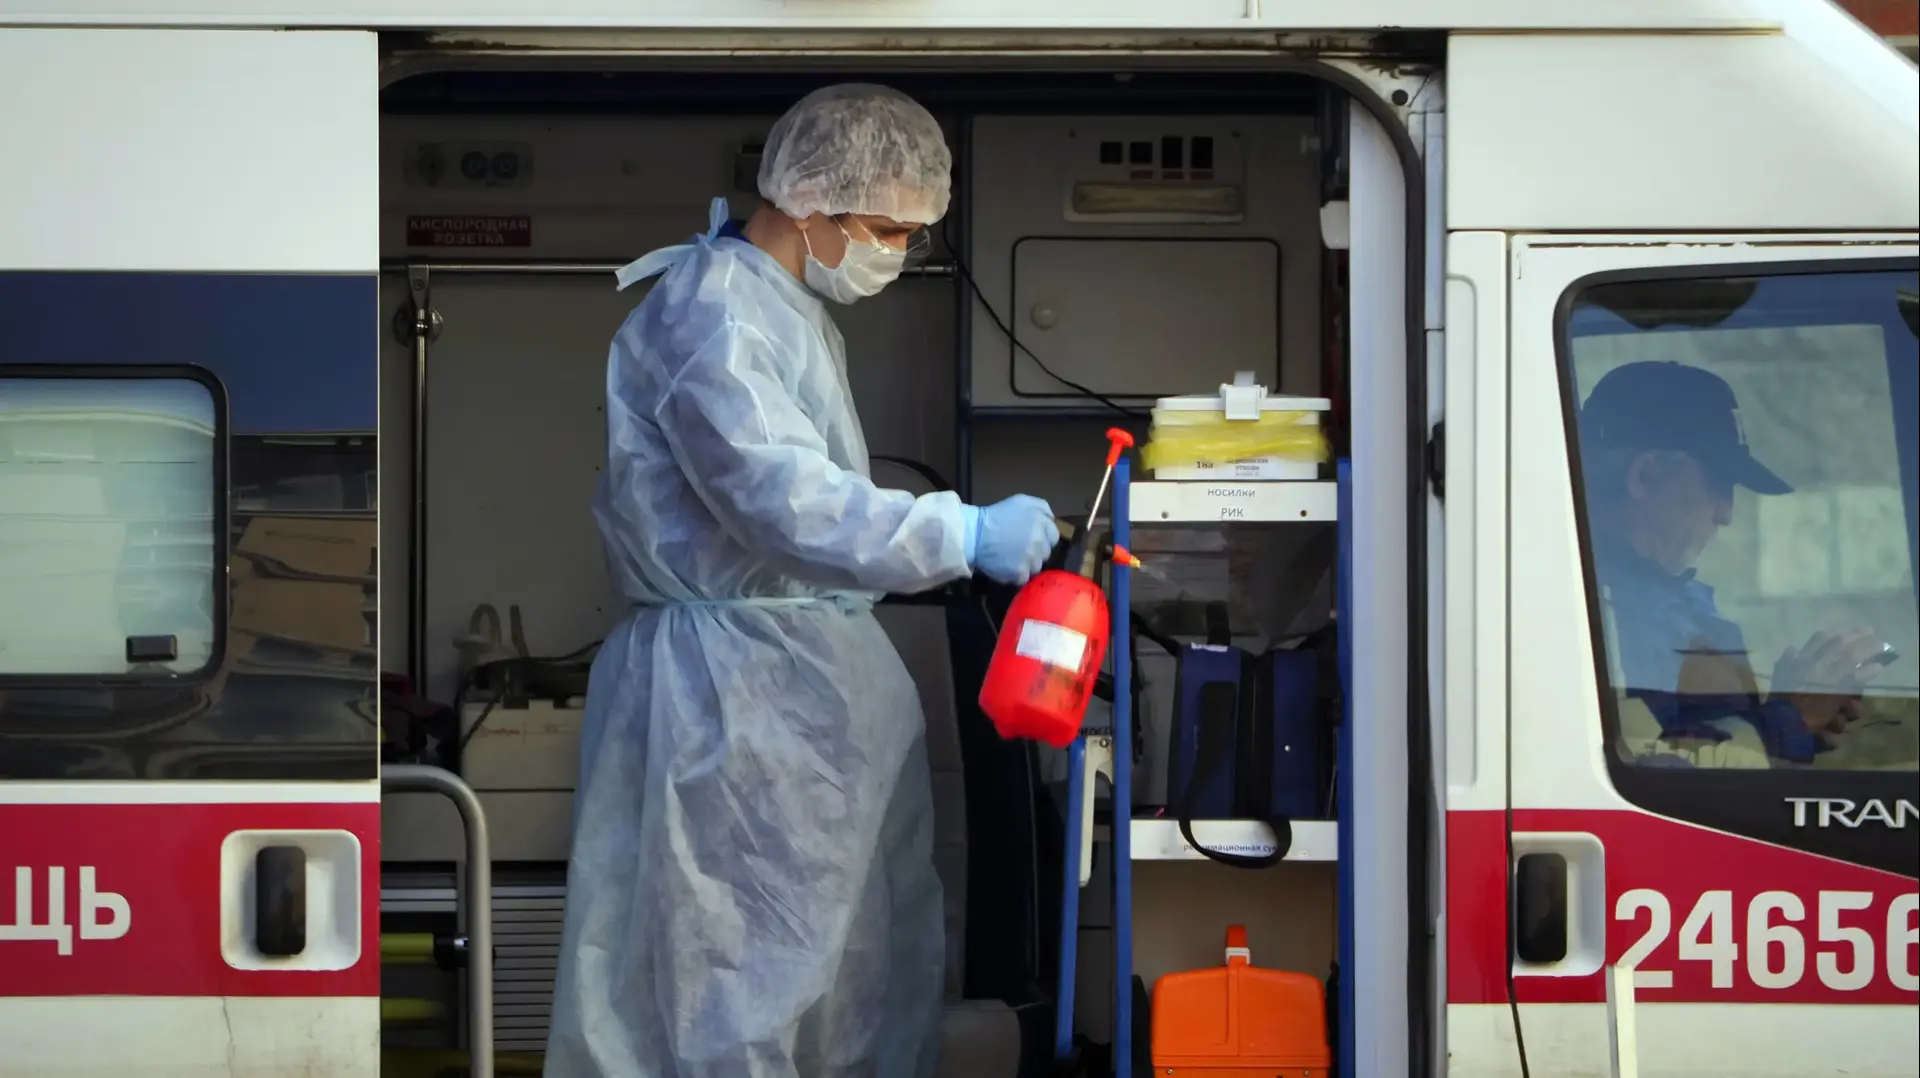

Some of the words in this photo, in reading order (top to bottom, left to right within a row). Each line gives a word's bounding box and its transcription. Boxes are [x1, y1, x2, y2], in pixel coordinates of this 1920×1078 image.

[410, 219, 529, 231] КИСЛОРОДНАЯ
[433, 233, 505, 245] РОЗЕТКА
[1220, 507, 1245, 518] РИК
[1614, 888, 1920, 992] 24656
